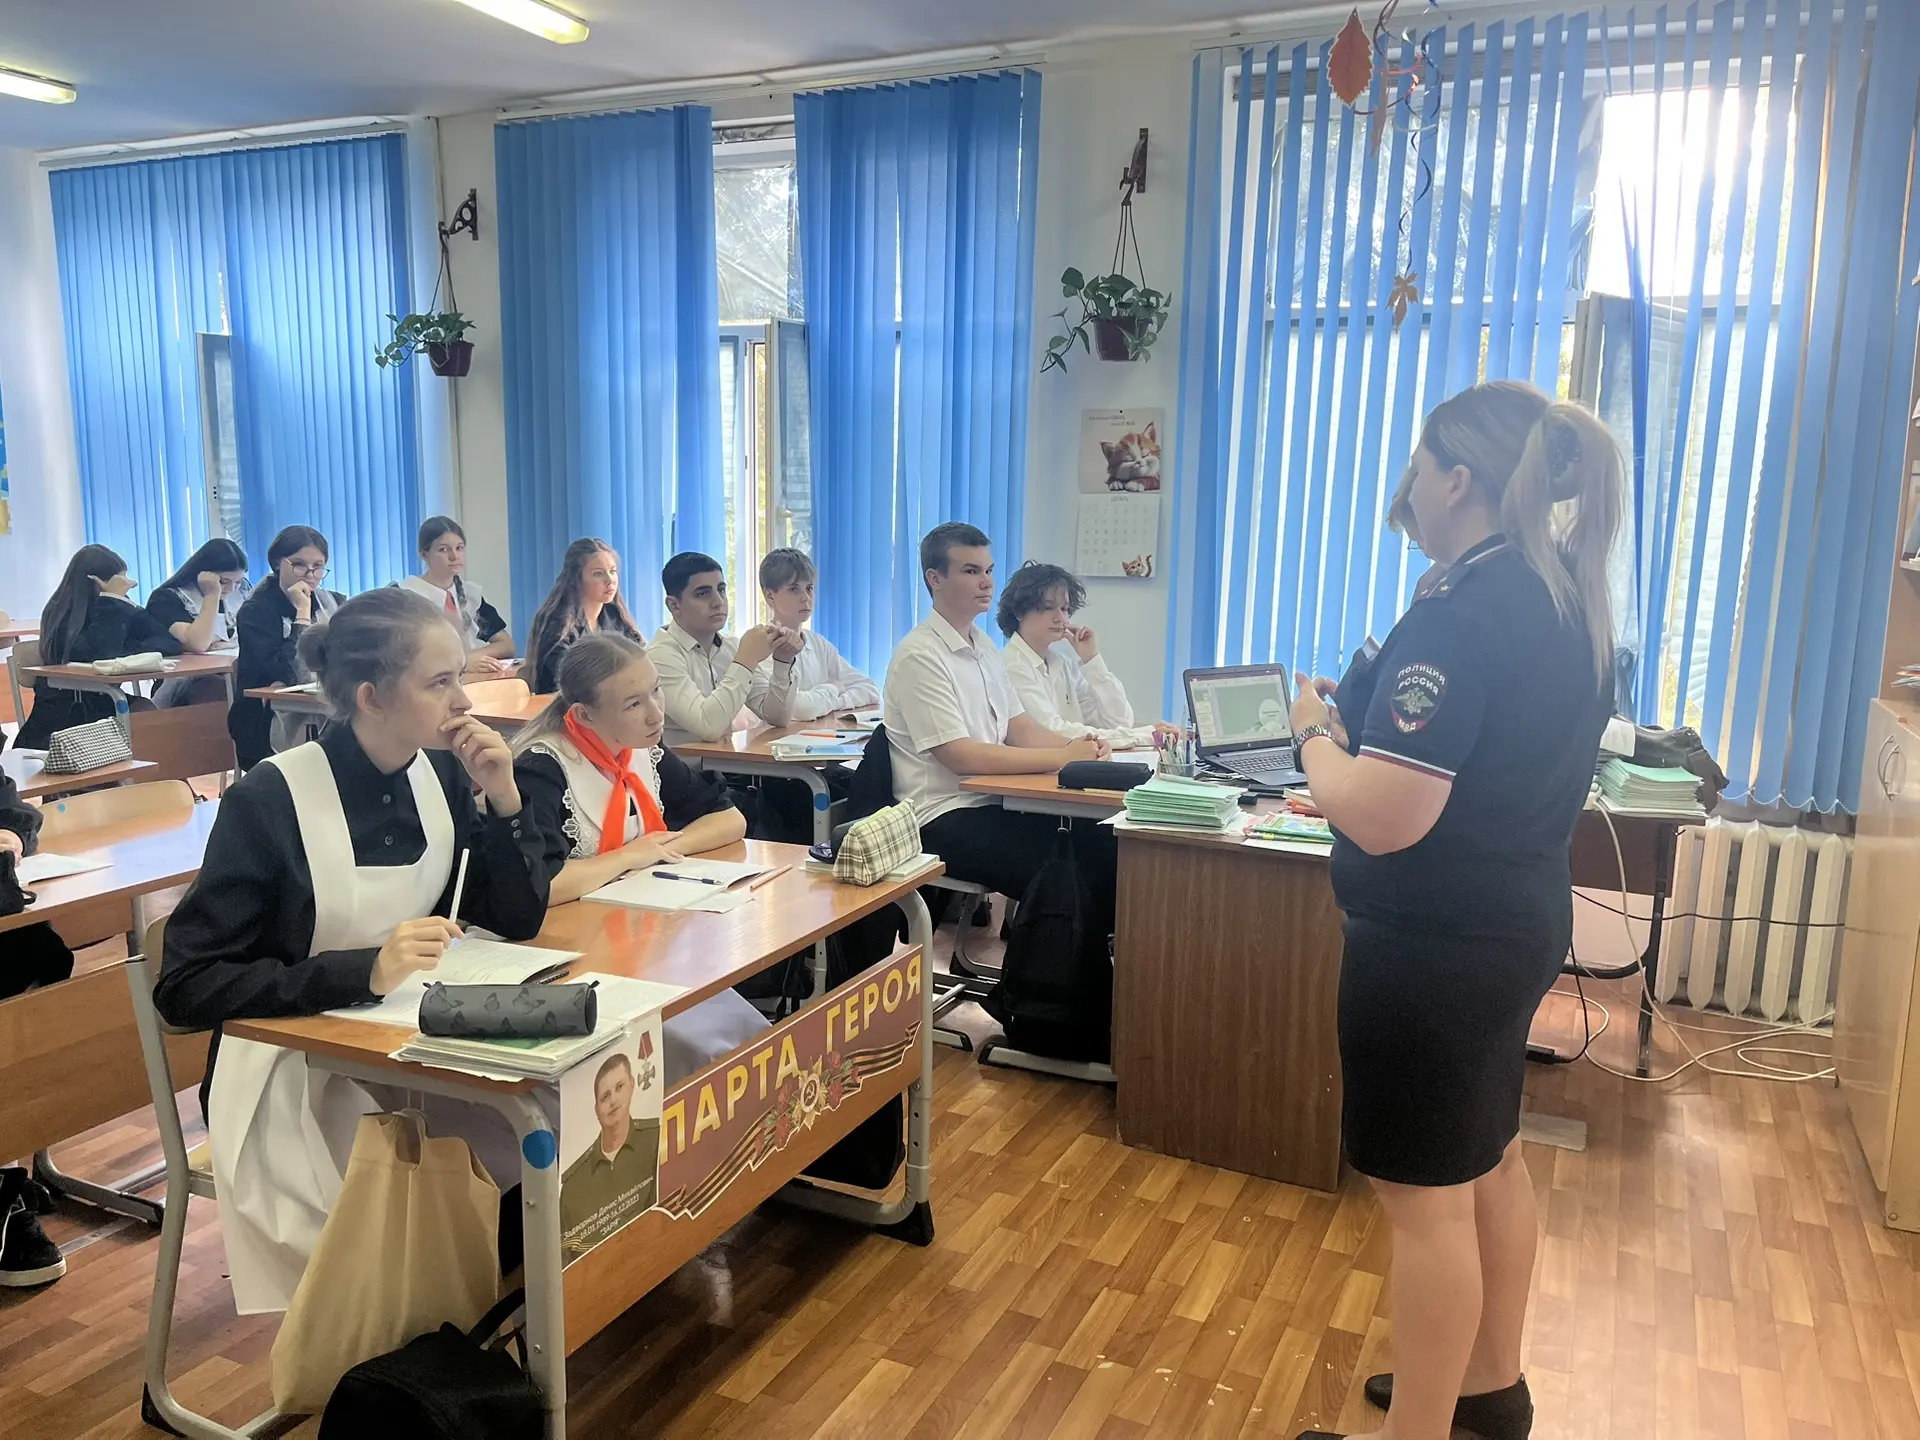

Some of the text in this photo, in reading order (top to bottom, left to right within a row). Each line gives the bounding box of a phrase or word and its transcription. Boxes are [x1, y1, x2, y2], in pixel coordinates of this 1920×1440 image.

[1397, 664, 1446, 685] ПОЛИЦИЯ
[1397, 675, 1439, 697] РОССИЯ
[1398, 718, 1417, 733] МВД
[660, 953, 921, 1167] ПАРТА ГЕРОЯ
[598, 1199, 618, 1218] Денис
